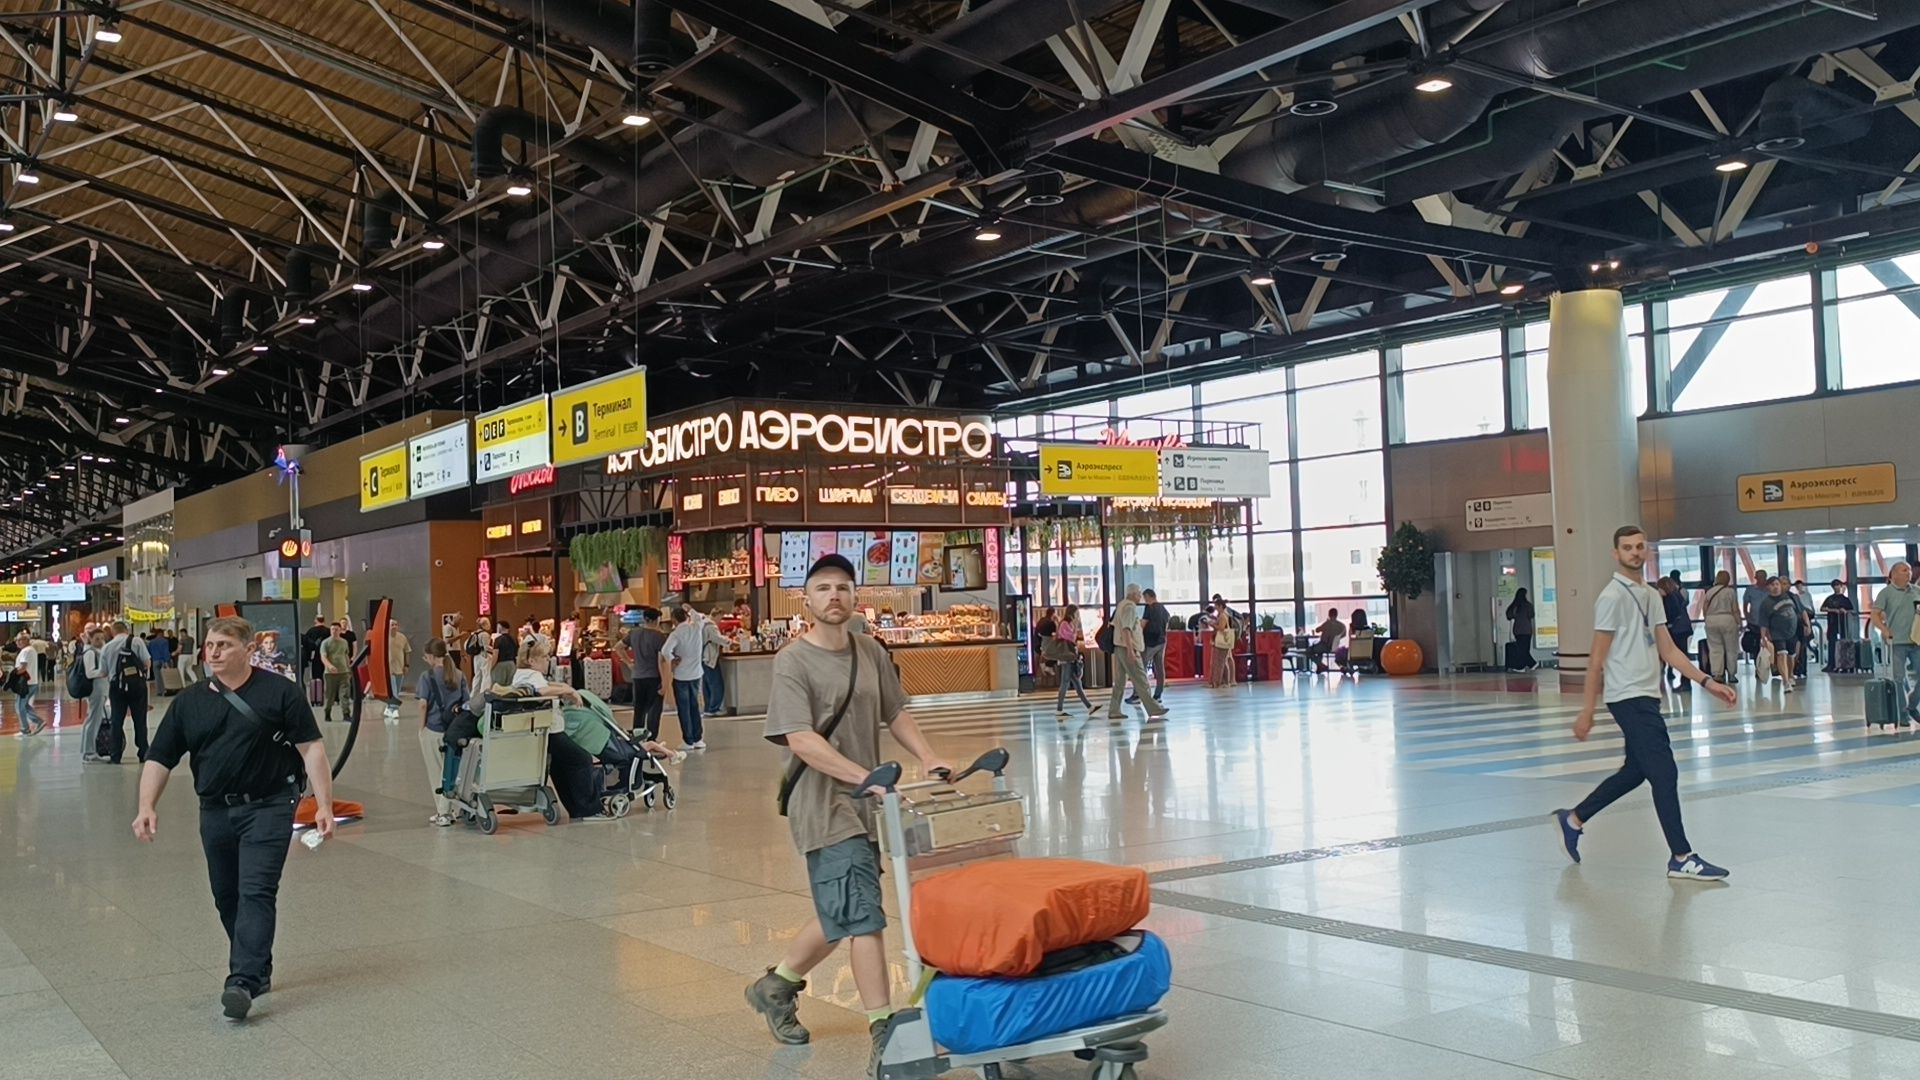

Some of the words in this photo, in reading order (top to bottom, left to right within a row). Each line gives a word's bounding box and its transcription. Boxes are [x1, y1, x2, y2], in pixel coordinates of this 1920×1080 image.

[593, 397, 632, 419] Терминал
[575, 409, 585, 438] B
[740, 409, 992, 459] АЭРОБИСТРО
[1076, 462, 1122, 471] Аэроэкспресс
[371, 471, 378, 492] C
[1790, 477, 1857, 490] Аэроэкспресс
[756, 486, 799, 502] ПИВО
